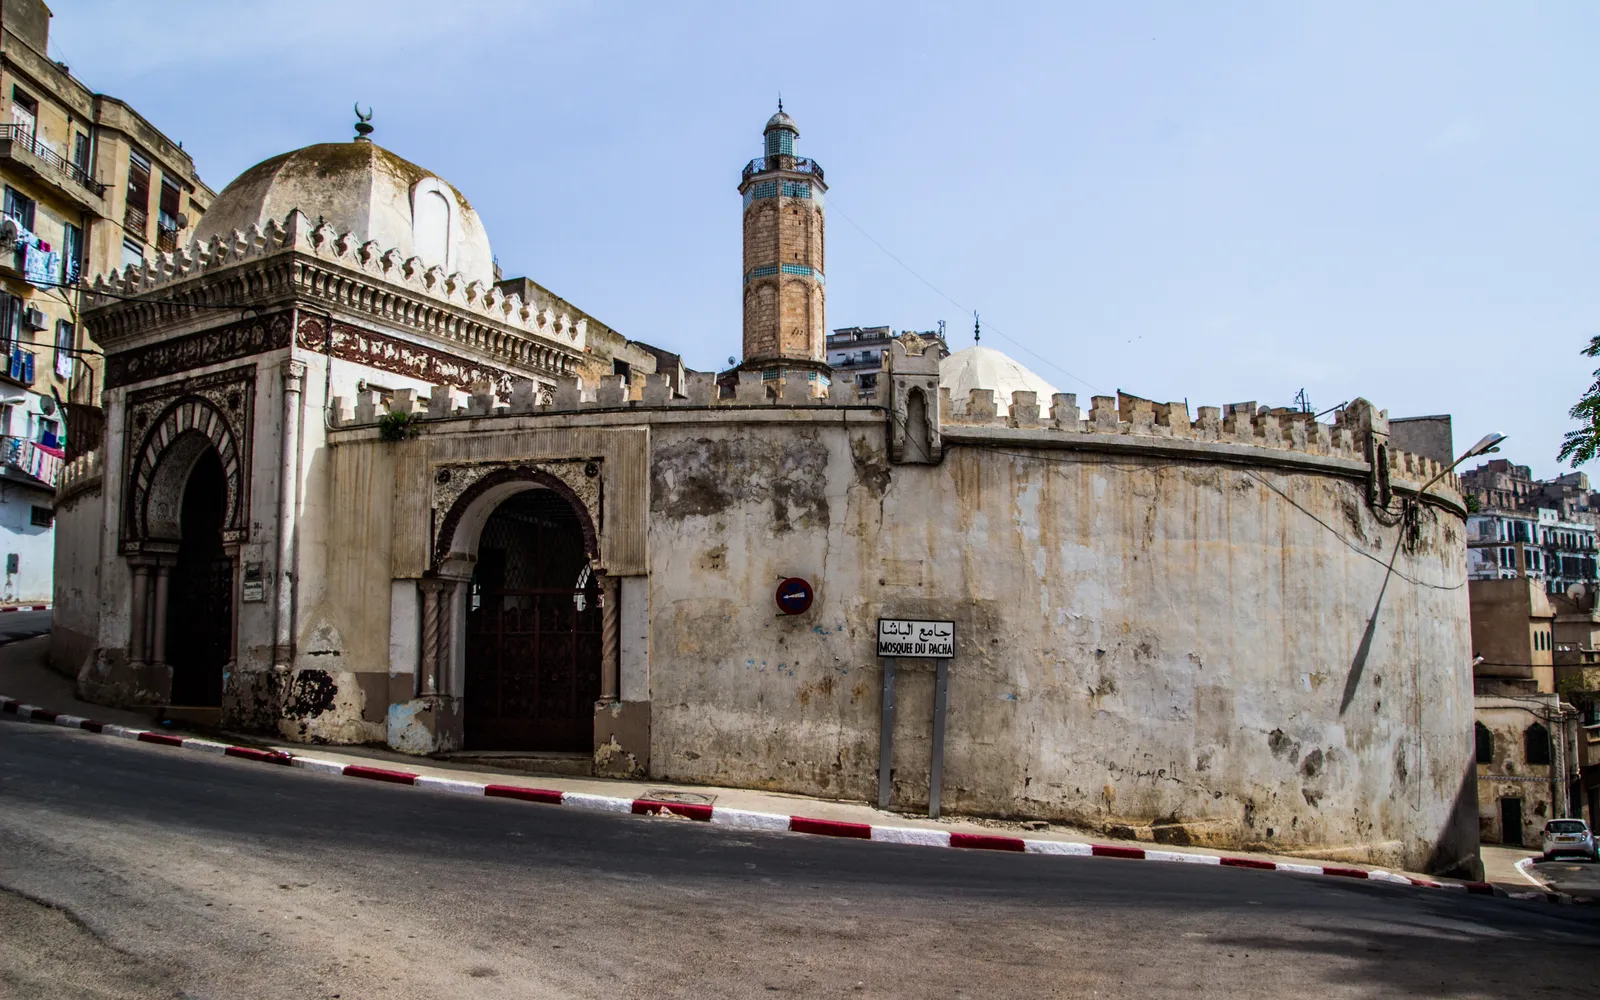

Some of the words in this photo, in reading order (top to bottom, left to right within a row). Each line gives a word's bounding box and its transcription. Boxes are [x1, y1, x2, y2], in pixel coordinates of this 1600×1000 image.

[882, 622, 913, 640] الباشا
[919, 624, 951, 642] جامع
[879, 641, 913, 654] MOSQUEE
[915, 643, 926, 654] DU
[929, 643, 952, 654] PACHA
